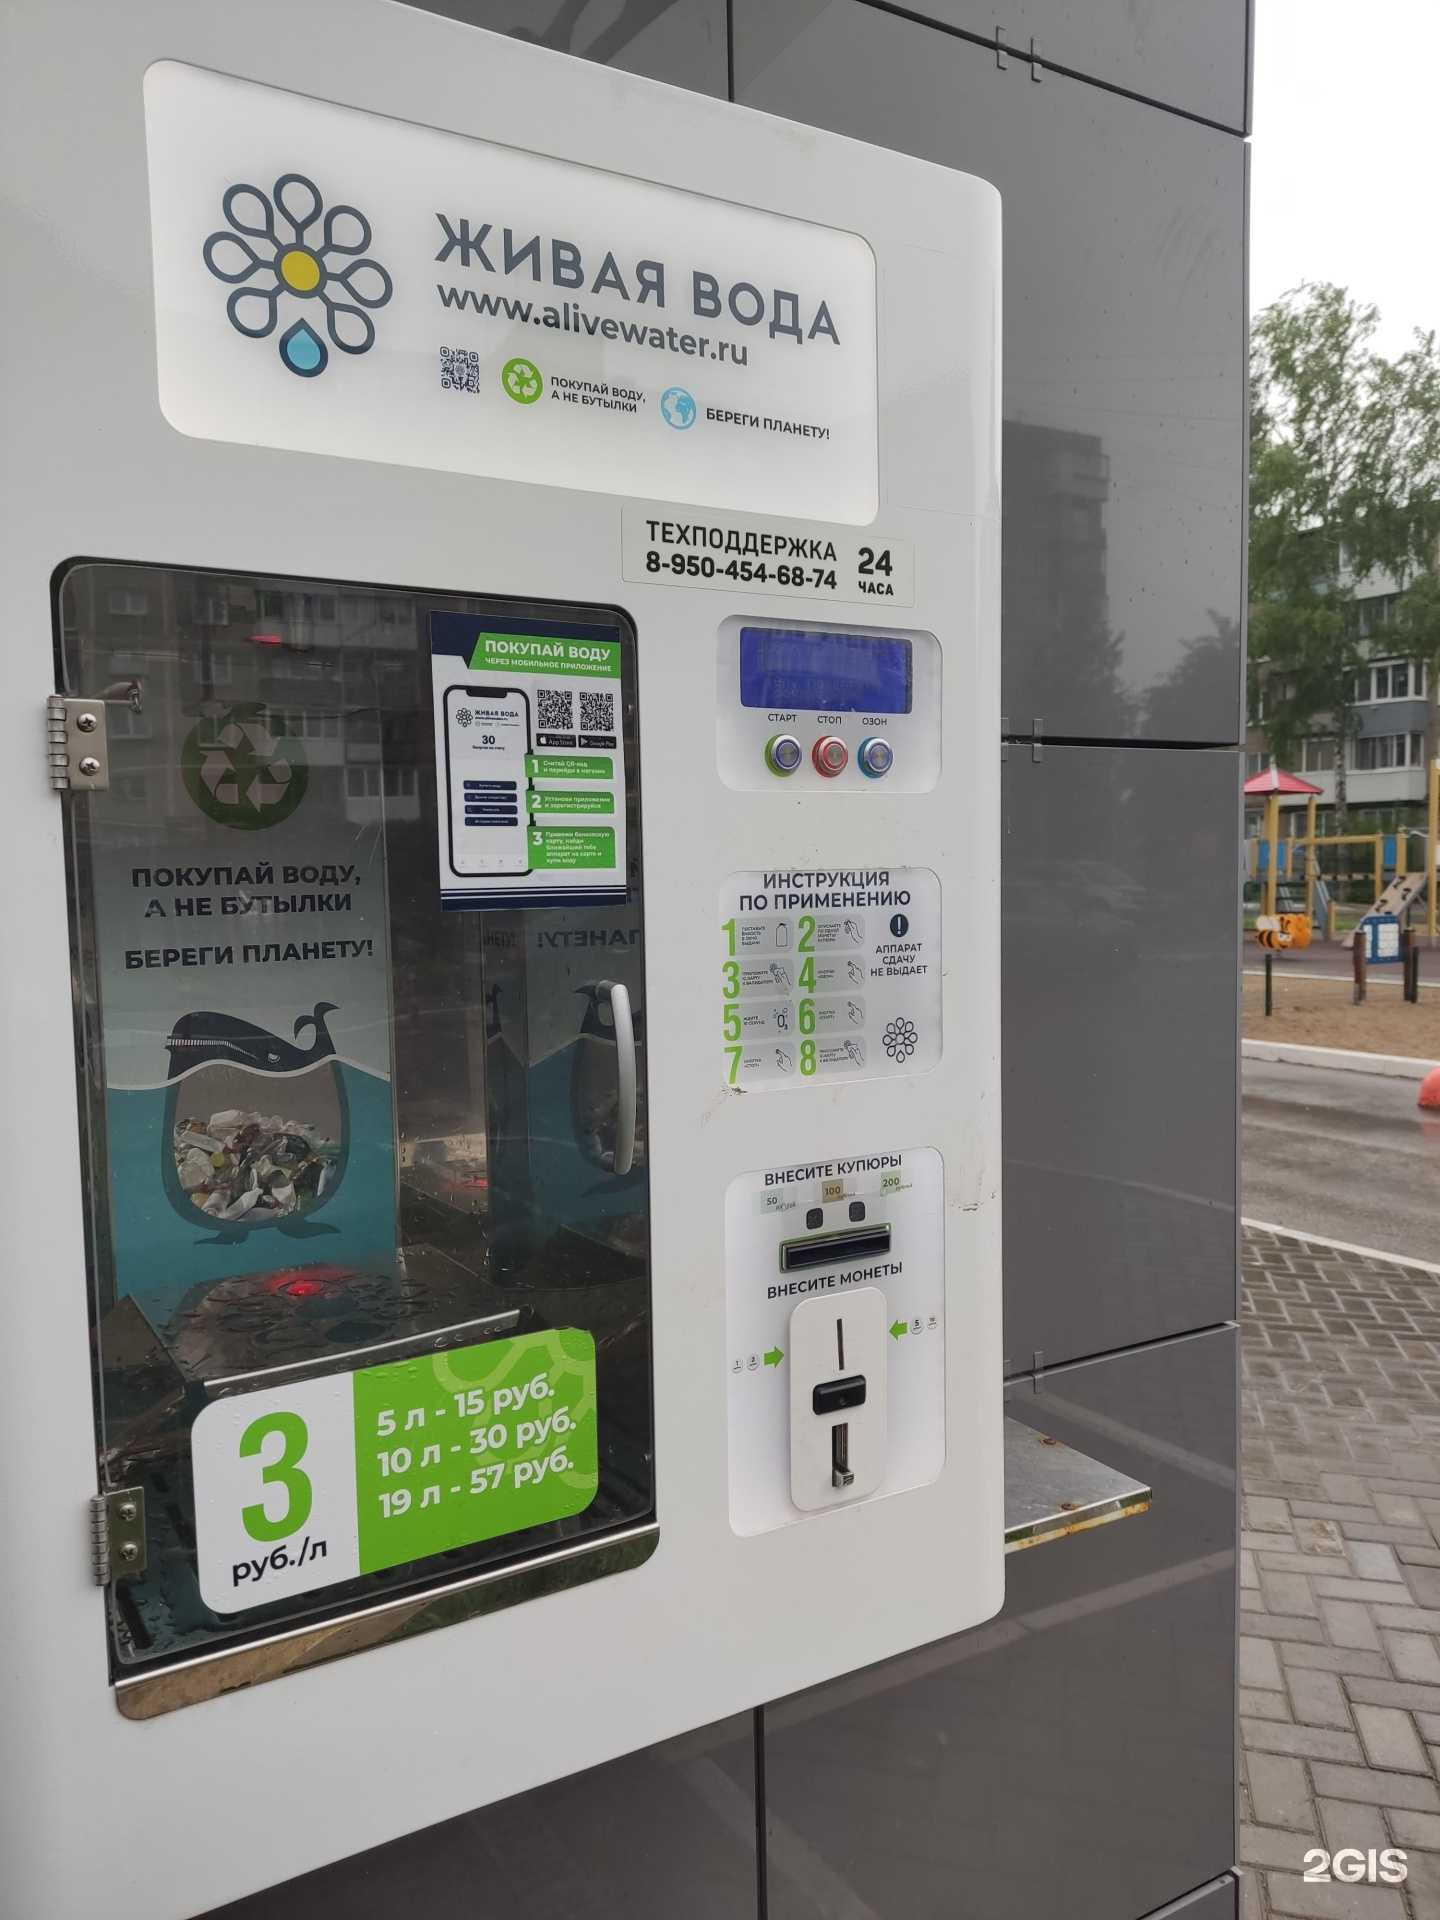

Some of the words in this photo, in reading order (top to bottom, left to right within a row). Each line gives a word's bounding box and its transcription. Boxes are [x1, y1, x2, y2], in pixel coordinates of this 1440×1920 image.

[435, 213, 665, 308] ЖИВАЯ
[692, 270, 841, 345] ВОДА
[437, 284, 748, 366] www.alivewater.ru
[551, 376, 609, 396] ПОКУПАЙ
[612, 387, 646, 403] ВОДУ,
[551, 391, 560, 400] А
[563, 392, 579, 403] НЕ
[581, 395, 637, 413] БУТЫЛКИ
[706, 407, 759, 428] БЕРЕГИ
[763, 417, 830, 440] ПЛАНЕТУ!
[645, 520, 837, 561] ТЕХПОДДЕРЖКА
[645, 551, 837, 590] 8-950-454-68-74
[857, 547, 893, 577] 24
[858, 581, 894, 596] ЧАСА
[485, 640, 564, 658] ПОКУПАЙ
[569, 646, 611, 662] ВОДУ
[485, 657, 510, 665] ЧЕРЕЗ
[511, 659, 560, 669] МОБИЛЬНОЕ
[560, 662, 612, 672] ПРИЛОЖЕНИЕ
[767, 713, 798, 723] СТАРТ
[817, 715, 842, 725] СТОП
[862, 717, 888, 726] ОЗОН
[482, 735, 496, 744] 30
[532, 759, 539, 773] 1
[531, 795, 542, 808] 2
[532, 831, 543, 846] 3
[132, 862, 274, 887] ПОКУПАЙ
[282, 865, 361, 886] ВОДУ,
[763, 871, 890, 889] ИНСТРУКЦИЯ
[144, 899, 167, 918] А
[174, 897, 213, 916] НЕ
[221, 893, 352, 915] БУТЫЛКИ
[739, 894, 768, 911] ПО
[774, 890, 911, 910] ПРИМЕНЕНИЮ
[721, 918, 736, 956] 1
[798, 915, 816, 953] 2
[125, 946, 233, 969] БЕРЕГИ
[243, 939, 373, 963] ПЛАНЕТУ!
[875, 943, 923, 954] АППАРАТ
[882, 954, 916, 965] СДАЧУ
[722, 960, 740, 999] 3
[798, 956, 817, 993] 4
[870, 966, 884, 976] НЕ
[886, 965, 928, 976] ВЫДАЕТ
[723, 1003, 741, 1041] 5
[799, 998, 816, 1035] 6
[724, 1045, 743, 1085] 7
[800, 1039, 816, 1076] 8
[764, 1164, 833, 1186] ВНЕСИТЕ
[837, 1154, 902, 1175] КУПЮРЫ
[882, 1177, 900, 1188] 200
[766, 1196, 778, 1206] 50
[824, 1185, 841, 1196] 100
[767, 1276, 836, 1299] ВНЕСИТЕ
[840, 1262, 903, 1286] МОНЕТЫ
[377, 1409, 396, 1436] 5
[404, 1408, 425, 1431] л
[454, 1389, 484, 1417] 15
[493, 1372, 555, 1415] руб.
[377, 1447, 412, 1477] 10
[420, 1444, 441, 1467] л
[469, 1424, 508, 1454] 30
[516, 1406, 577, 1448] руб.
[239, 1411, 313, 1542] 3
[378, 1488, 412, 1518] 19
[420, 1485, 441, 1508] л
[470, 1463, 505, 1494] 57
[514, 1445, 574, 1488] руб.
[232, 1536, 328, 1587] руб./л
